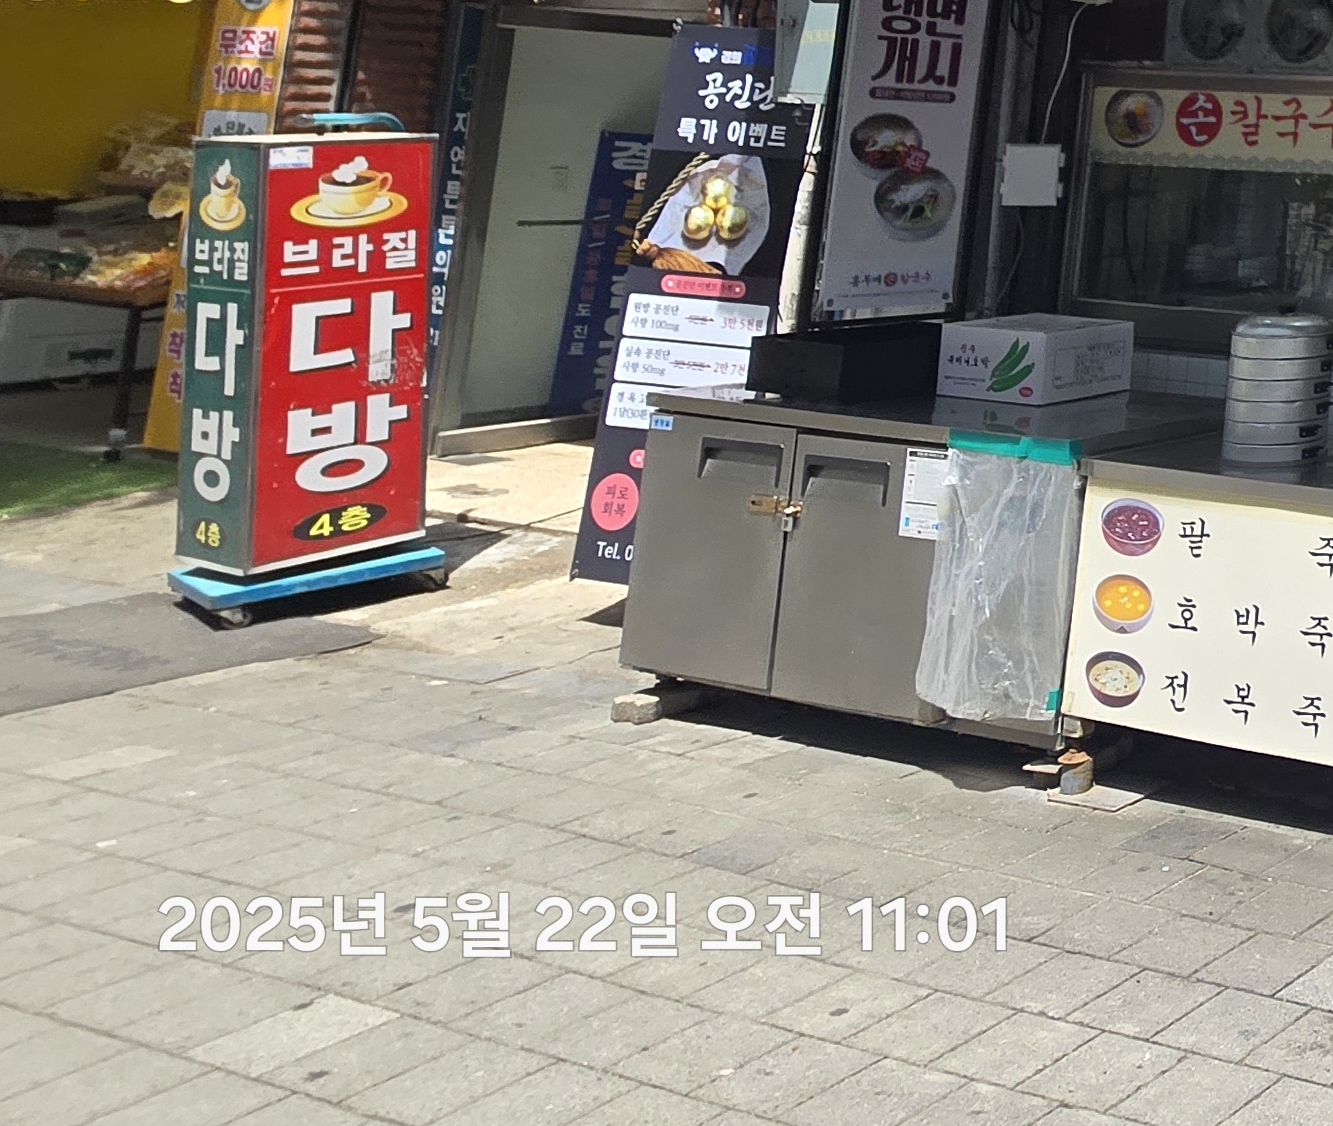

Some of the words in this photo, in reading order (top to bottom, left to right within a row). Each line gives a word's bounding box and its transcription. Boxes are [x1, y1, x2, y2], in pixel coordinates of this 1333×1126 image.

[218, 28, 278, 58] 무조건
[870, 35, 963, 87] 개시
[697, 70, 777, 112] 공진단
[676, 116, 719, 145] 특가
[726, 120, 787, 149] 이벤트
[193, 236, 250, 281] 브라질
[280, 227, 418, 278] 브라질
[653, 302, 680, 317] 공진단
[650, 318, 680, 333] 100mg
[644, 346, 671, 361] 공진단
[640, 362, 666, 377] 50mg
[604, 484, 629, 501] 피로
[307, 504, 373, 538] 4층
[601, 502, 627, 518] 회복
[194, 519, 221, 548] 4층
[596, 541, 621, 560] Tel.
